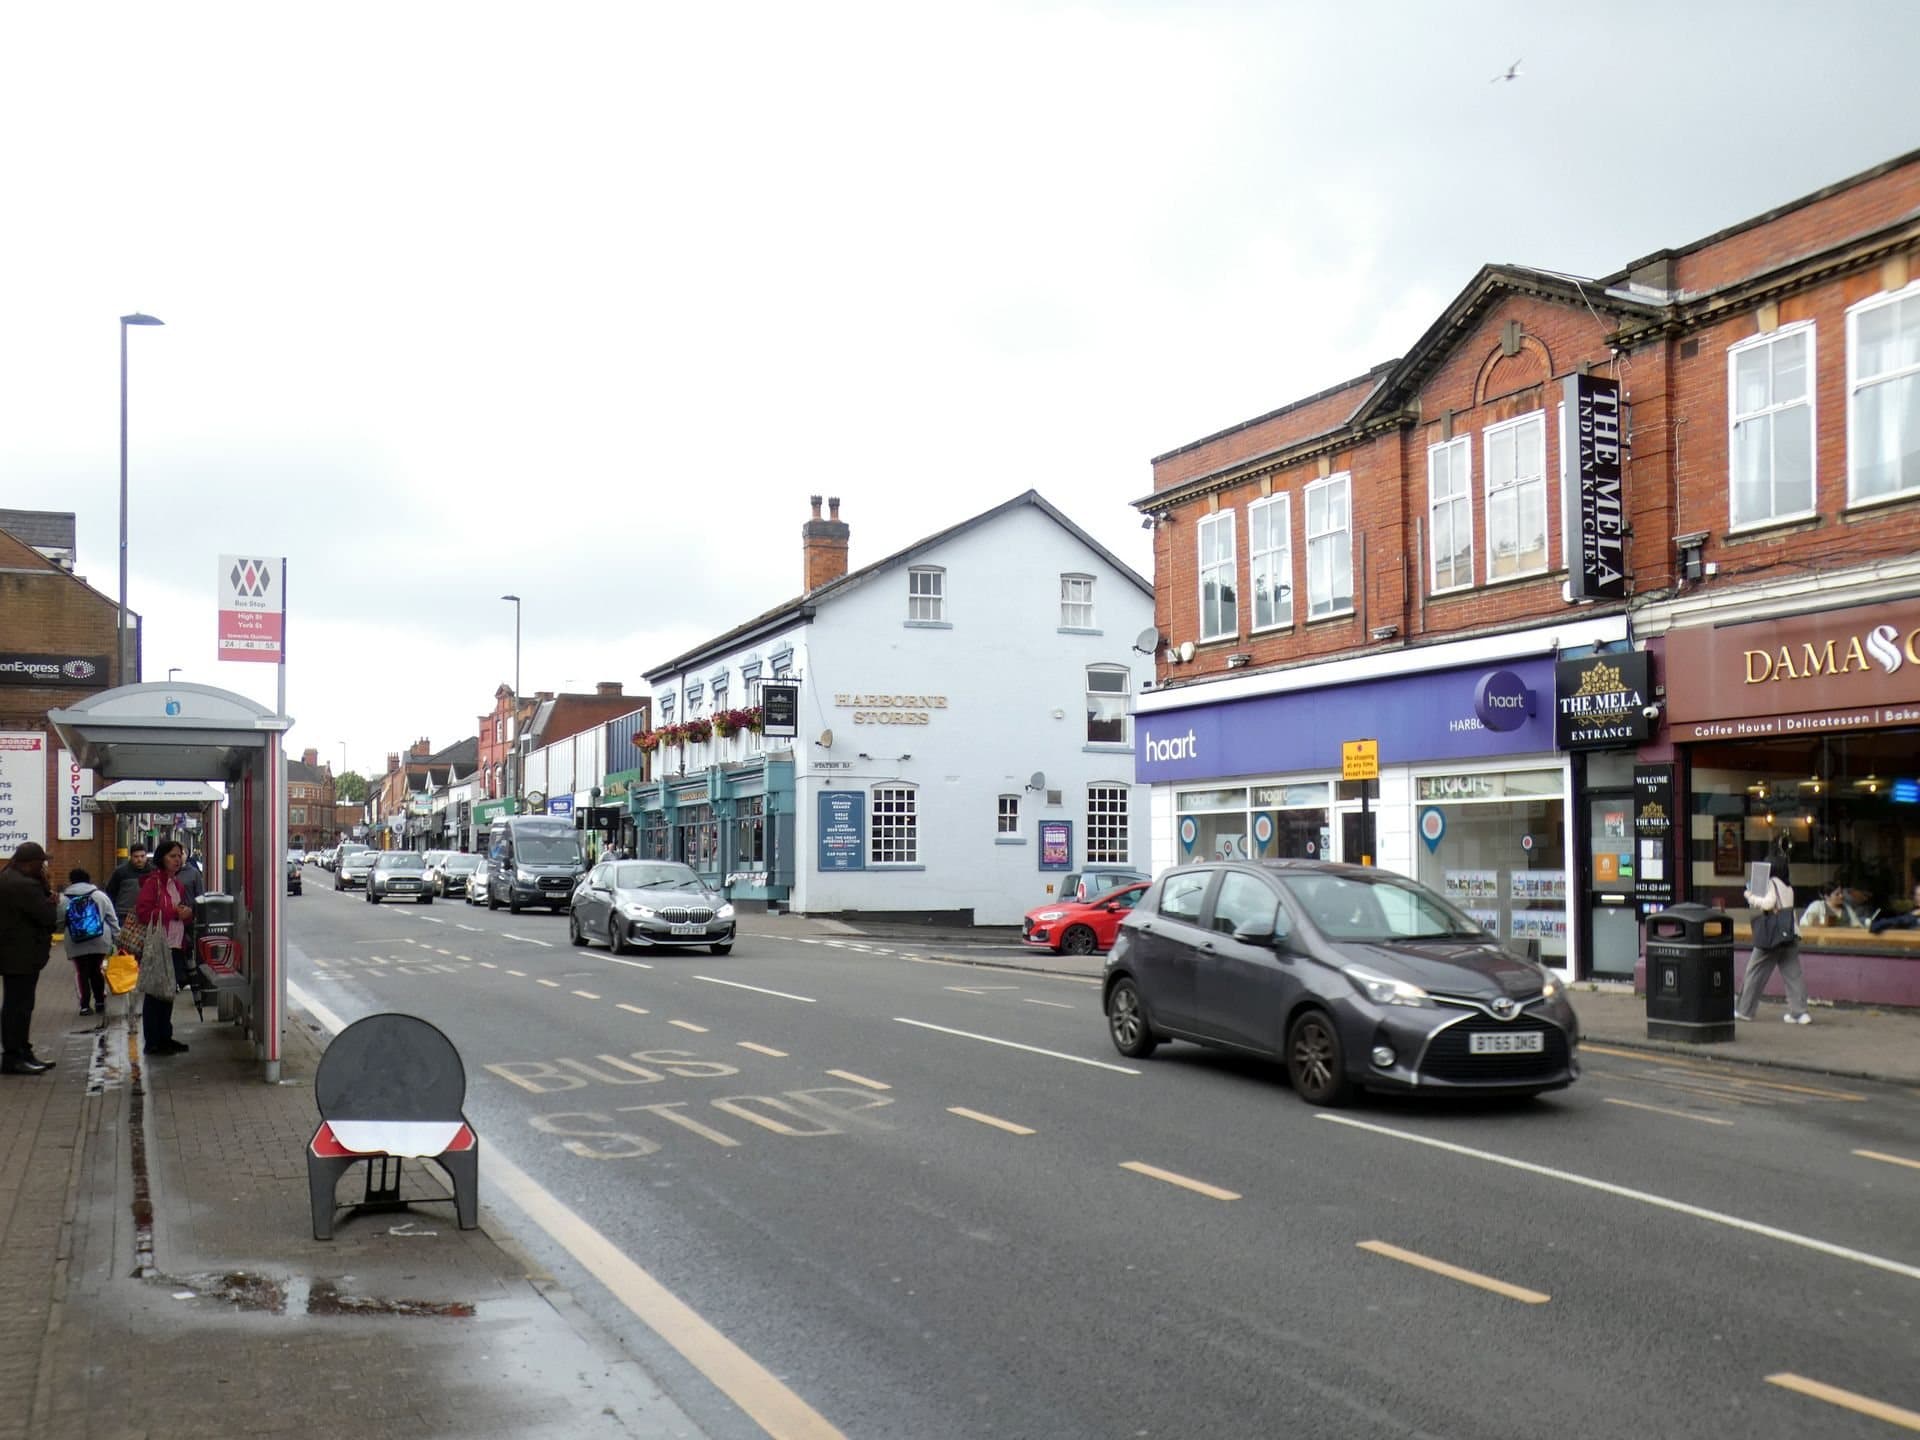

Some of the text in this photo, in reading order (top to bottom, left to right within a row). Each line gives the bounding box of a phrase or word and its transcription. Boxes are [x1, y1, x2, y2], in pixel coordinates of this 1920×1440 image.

[1579, 396, 1597, 576] INDIAN KITCHEN
[1593, 389, 1623, 588] THE MELA
[834, 694, 948, 709] HARBORNE
[1487, 691, 1524, 708] haart
[1560, 691, 1642, 713] THE MELA
[853, 711, 929, 725] STORES
[1695, 726, 1733, 737] Coffee
[1738, 722, 1773, 733] House
[1787, 714, 1870, 730] Delicatessen
[1571, 726, 1633, 741] ENTRANCE
[1146, 728, 1197, 762] haart
[1636, 776, 1668, 784] WELCOME
[1648, 785, 1657, 793] TO
[482, 1050, 740, 1095] BUS
[528, 1087, 896, 1160] STOP
